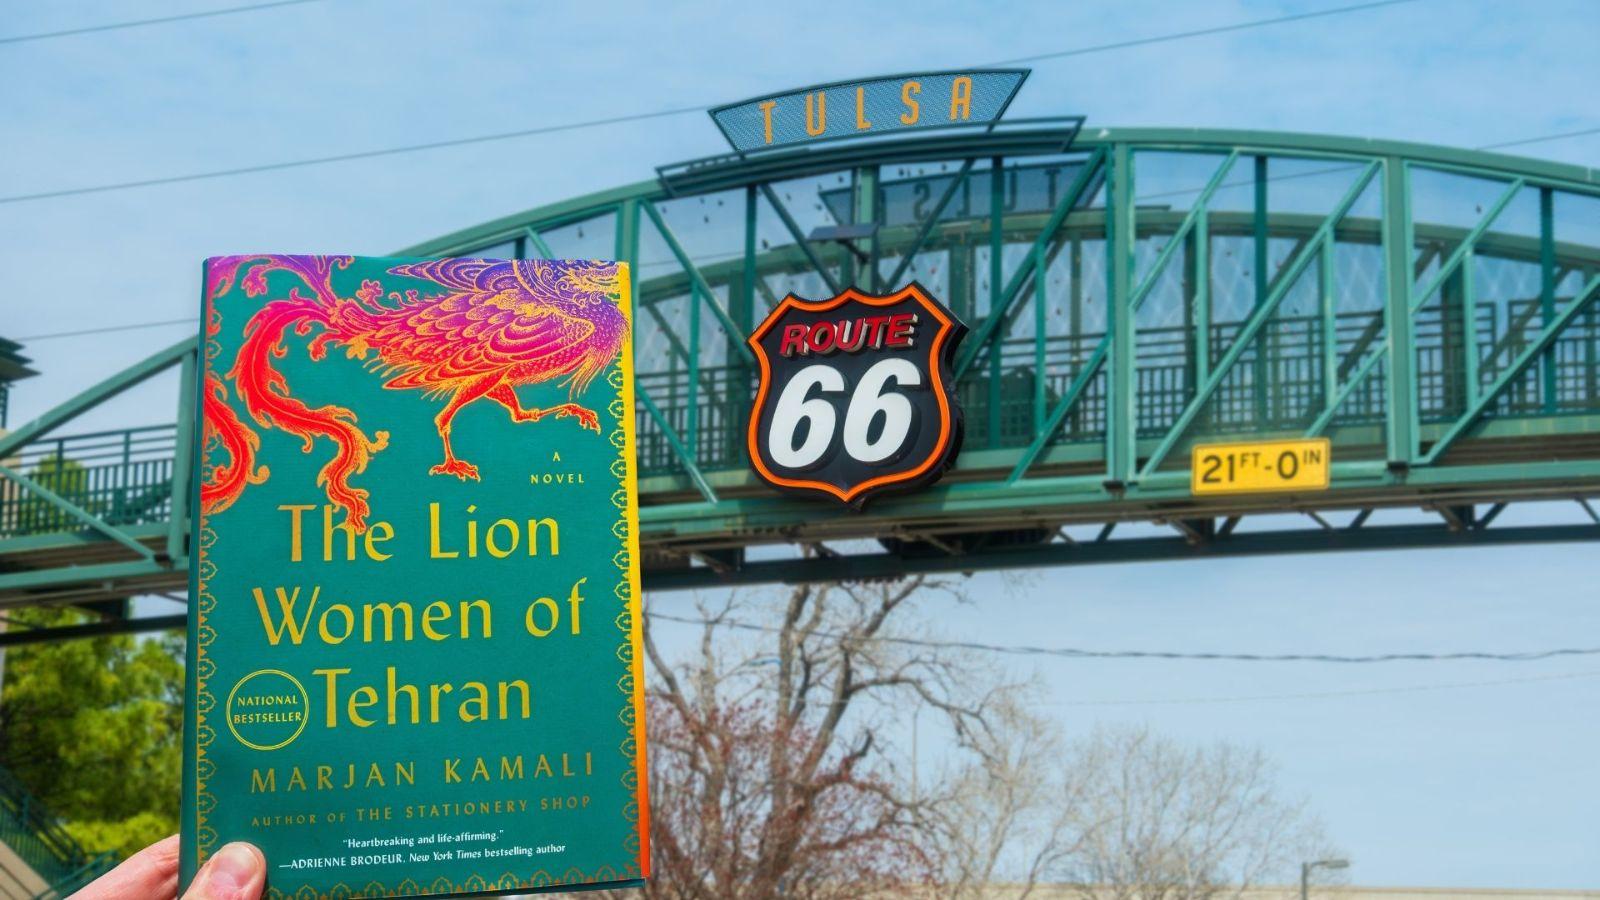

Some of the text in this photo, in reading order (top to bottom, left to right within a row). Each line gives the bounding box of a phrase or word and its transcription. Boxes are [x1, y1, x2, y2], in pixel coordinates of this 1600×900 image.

[759, 76, 973, 144] TULSA
[780, 313, 918, 356] ROUTE
[768, 358, 921, 468] 66
[552, 451, 561, 462] A
[530, 473, 585, 484] NOVEL
[277, 502, 559, 562] The Lion
[252, 577, 587, 646] Women of
[237, 694, 298, 707] NATIONAL
[312, 666, 531, 728] Tehran
[233, 711, 302, 724] BESTSELLER
[251, 752, 592, 794] MARJAN KAMALI
[251, 796, 590, 827] AUTHOR OF THE STATIONERY SHOP
[409, 852, 430, 863] New
[433, 850, 453, 861] York
[456, 849, 482, 859] Times
[484, 846, 533, 857] bestselling
[536, 844, 566, 854] author
[417, 834, 435, 845] and
